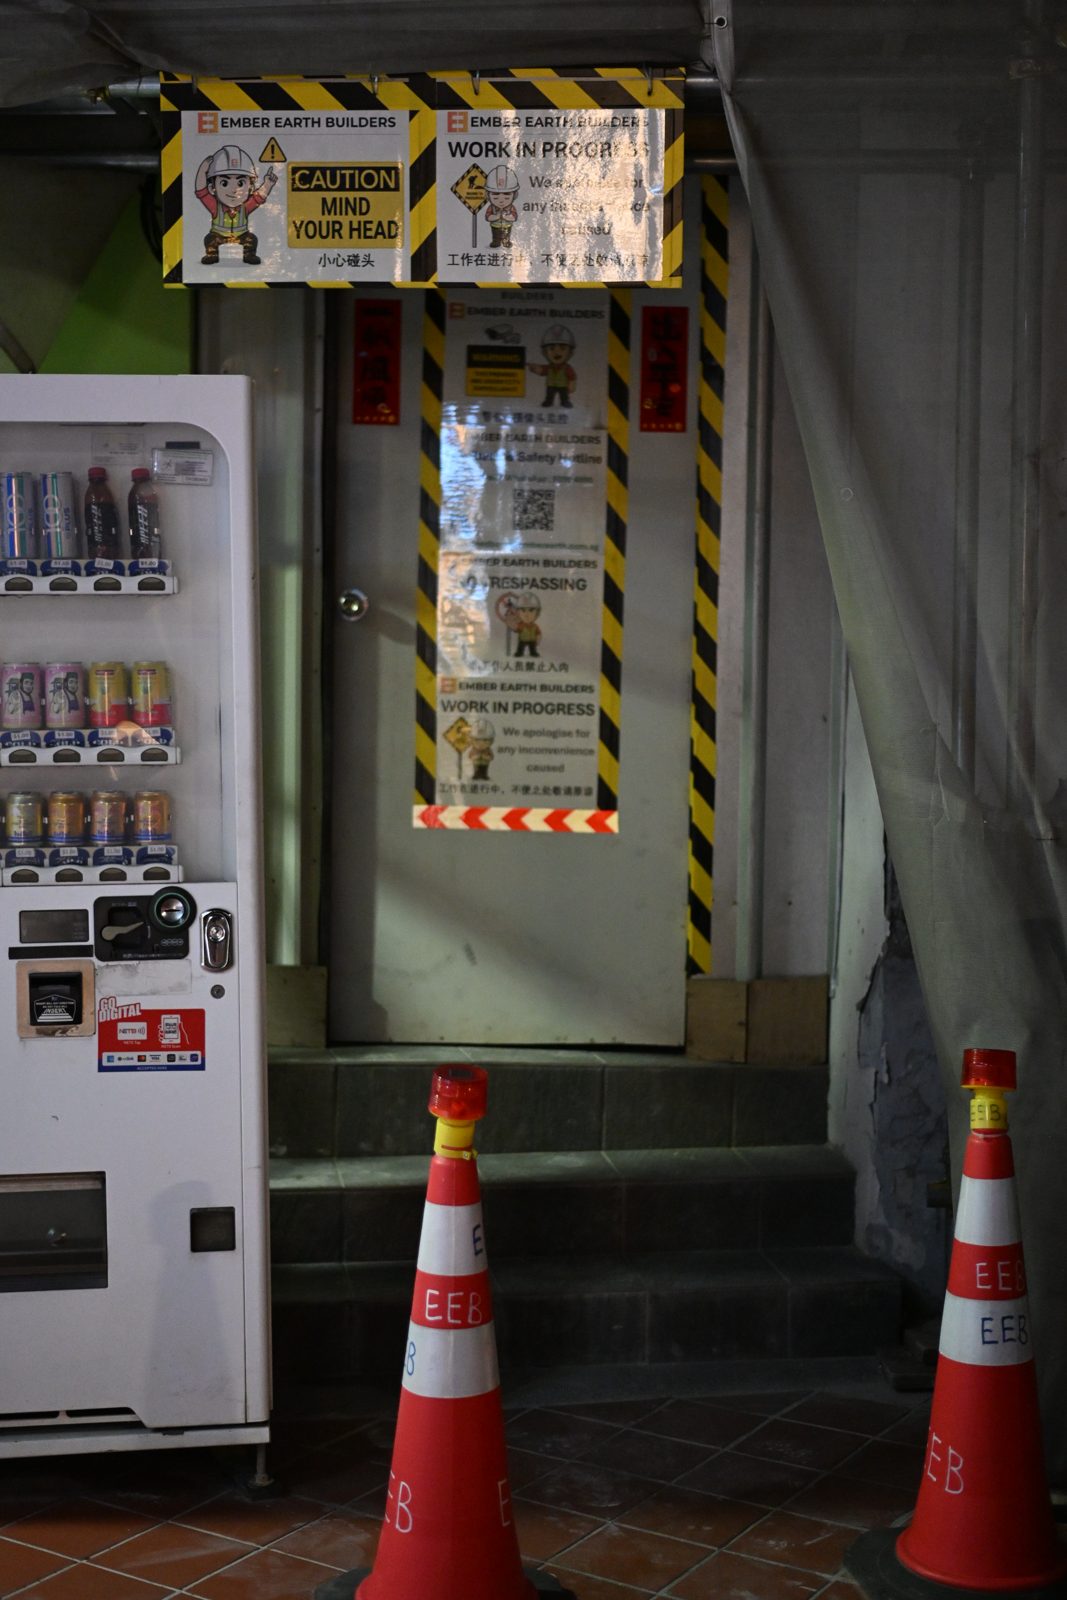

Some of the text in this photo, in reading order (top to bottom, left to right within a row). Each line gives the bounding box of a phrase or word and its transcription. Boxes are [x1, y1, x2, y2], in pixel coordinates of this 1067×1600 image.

[221, 116, 396, 128] EMBER EARTH BUILDERS
[471, 116, 521, 128] EMBER
[525, 116, 573, 128] EARTH
[448, 141, 510, 158] WORK
[517, 141, 536, 158] IN
[295, 169, 396, 189] CAUTION
[529, 176, 552, 188] We
[321, 197, 370, 216] MIND
[523, 202, 547, 214] any
[293, 220, 399, 240] YOUR HEAD
[318, 253, 375, 268] 小心碰头
[467, 307, 605, 319] EMBER EARTH BUILDERS
[518, 452, 556, 464] Safety
[503, 559, 540, 568] EARTH
[543, 560, 597, 569] BUILDERS
[486, 576, 587, 591] TRESPASSING
[458, 682, 595, 694] EMBER EARTH BUILDERS
[441, 700, 595, 716] WORK IN PROGRESS
[503, 727, 590, 739] We apologise for
[497, 746, 514, 756] any
[526, 764, 565, 773] caused
[100, 996, 116, 1010] GO
[99, 1003, 142, 1023] DIGITAL
[975, 1259, 1026, 1292] EEB
[424, 1288, 484, 1325] EEB
[981, 1314, 1029, 1345] EEB
